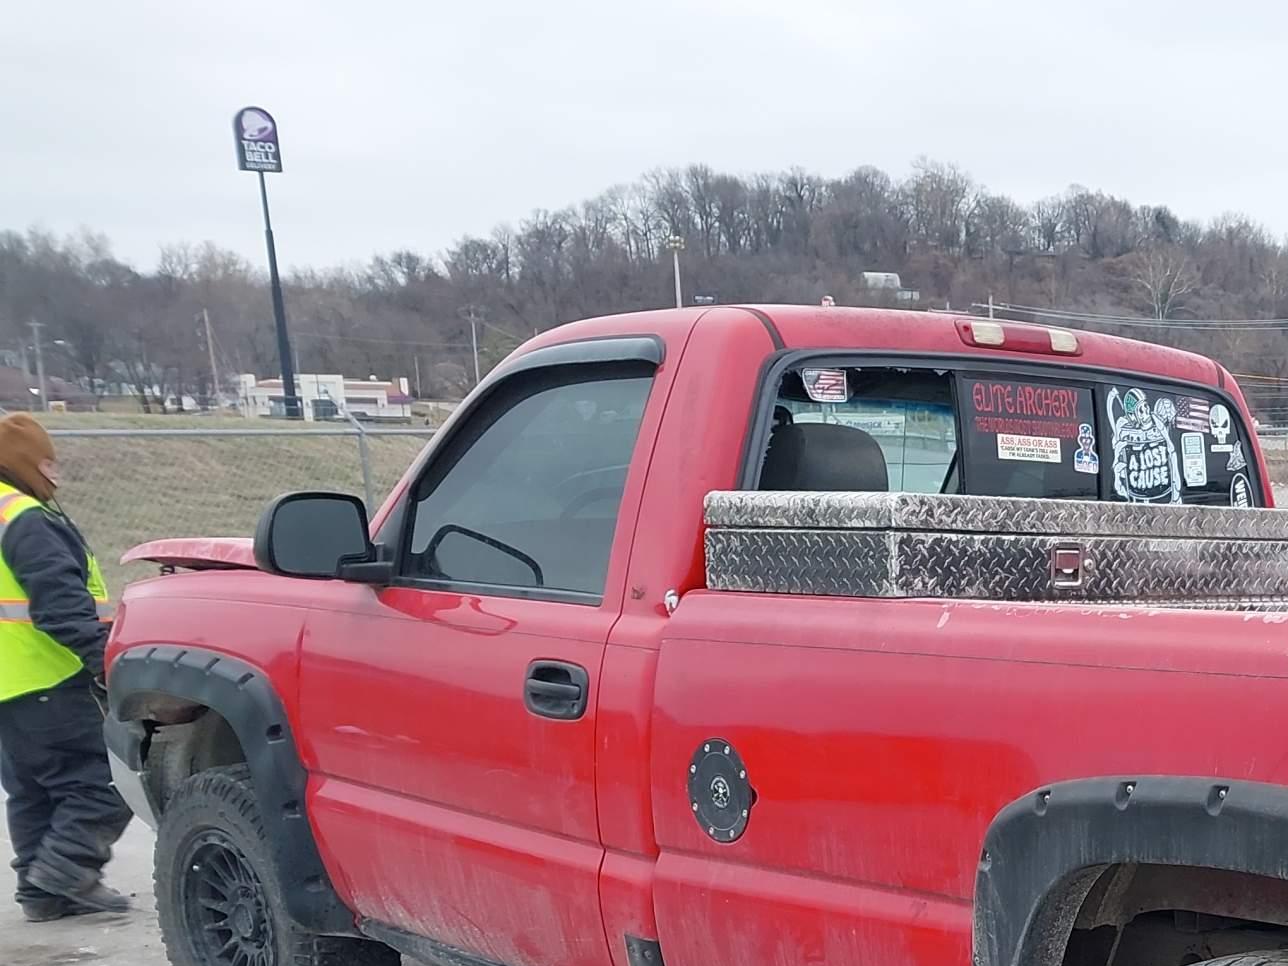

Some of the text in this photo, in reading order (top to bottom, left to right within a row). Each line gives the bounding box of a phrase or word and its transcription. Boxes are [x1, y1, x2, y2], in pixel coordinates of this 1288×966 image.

[241, 140, 275, 152] TACO
[246, 151, 277, 163] BELL
[972, 382, 1078, 418] ELITE ARCHERY
[1129, 454, 1139, 470] A
[1140, 445, 1167, 470] LOST
[1129, 466, 1169, 489] CAUSE
